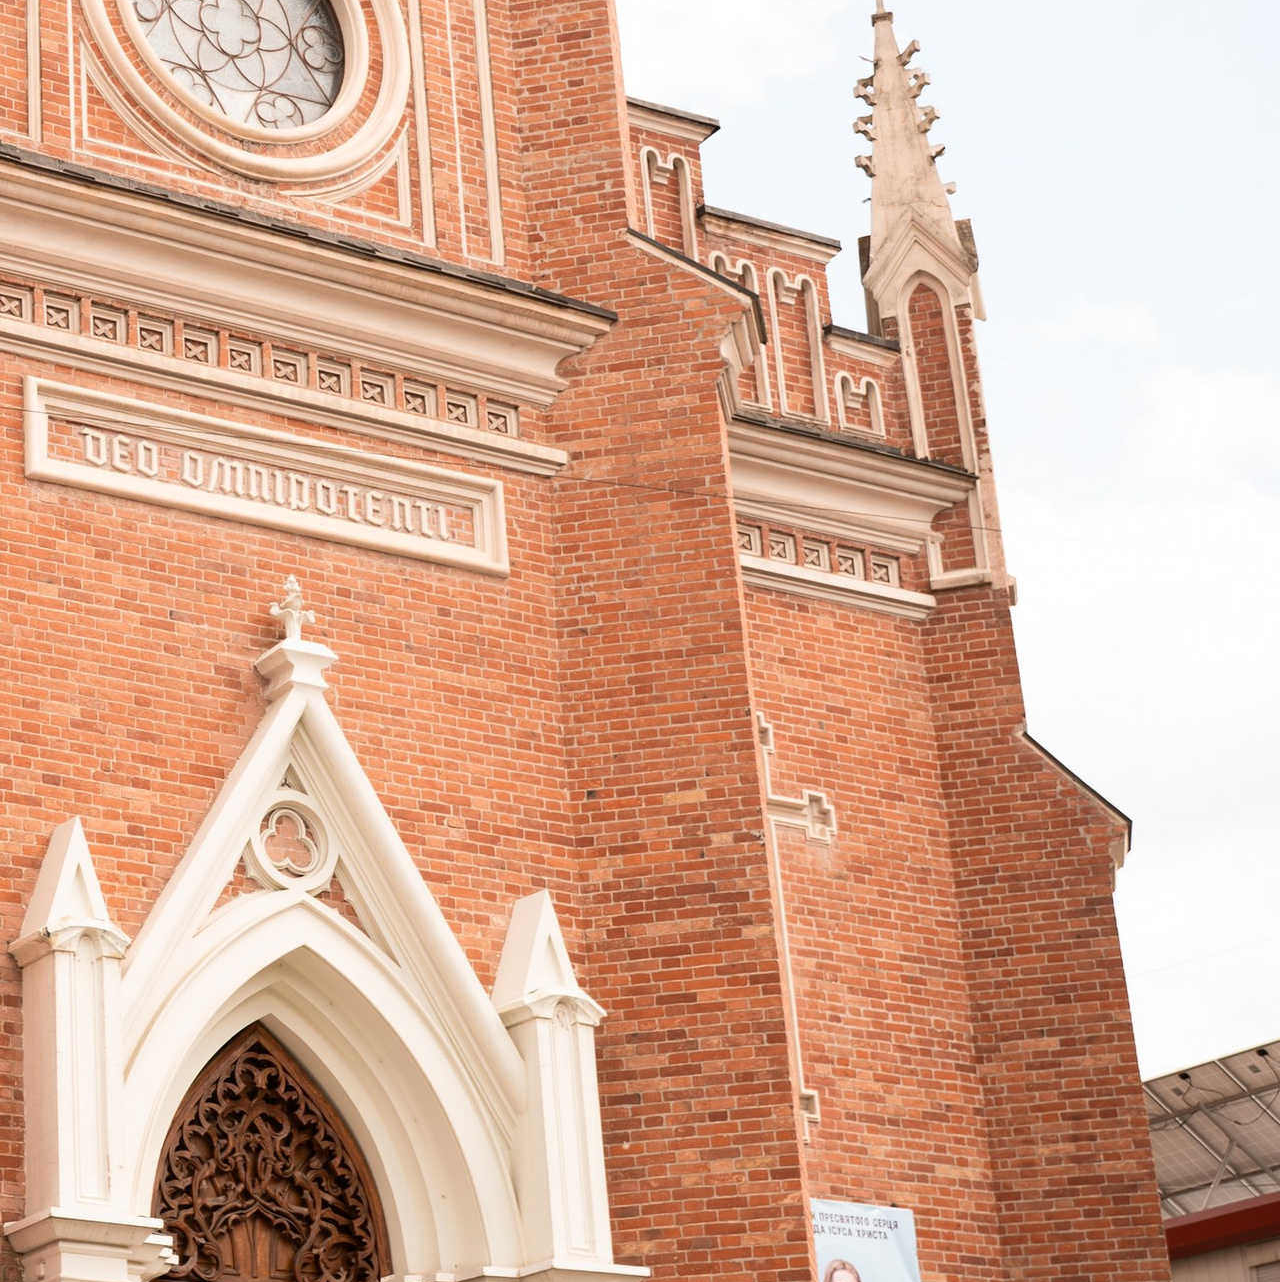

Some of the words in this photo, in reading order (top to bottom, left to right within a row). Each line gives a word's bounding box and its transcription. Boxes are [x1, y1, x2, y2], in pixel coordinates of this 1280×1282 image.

[80, 426, 159, 478] DEO
[180, 449, 451, 541] OMNIPOTENTI
[819, 1212, 870, 1226] ПРЕСВЯТОГО
[873, 1218, 898, 1231] СЕРЦЯ
[828, 1225, 853, 1237] ІСУСА
[856, 1229, 888, 1240] ХРИСТА
